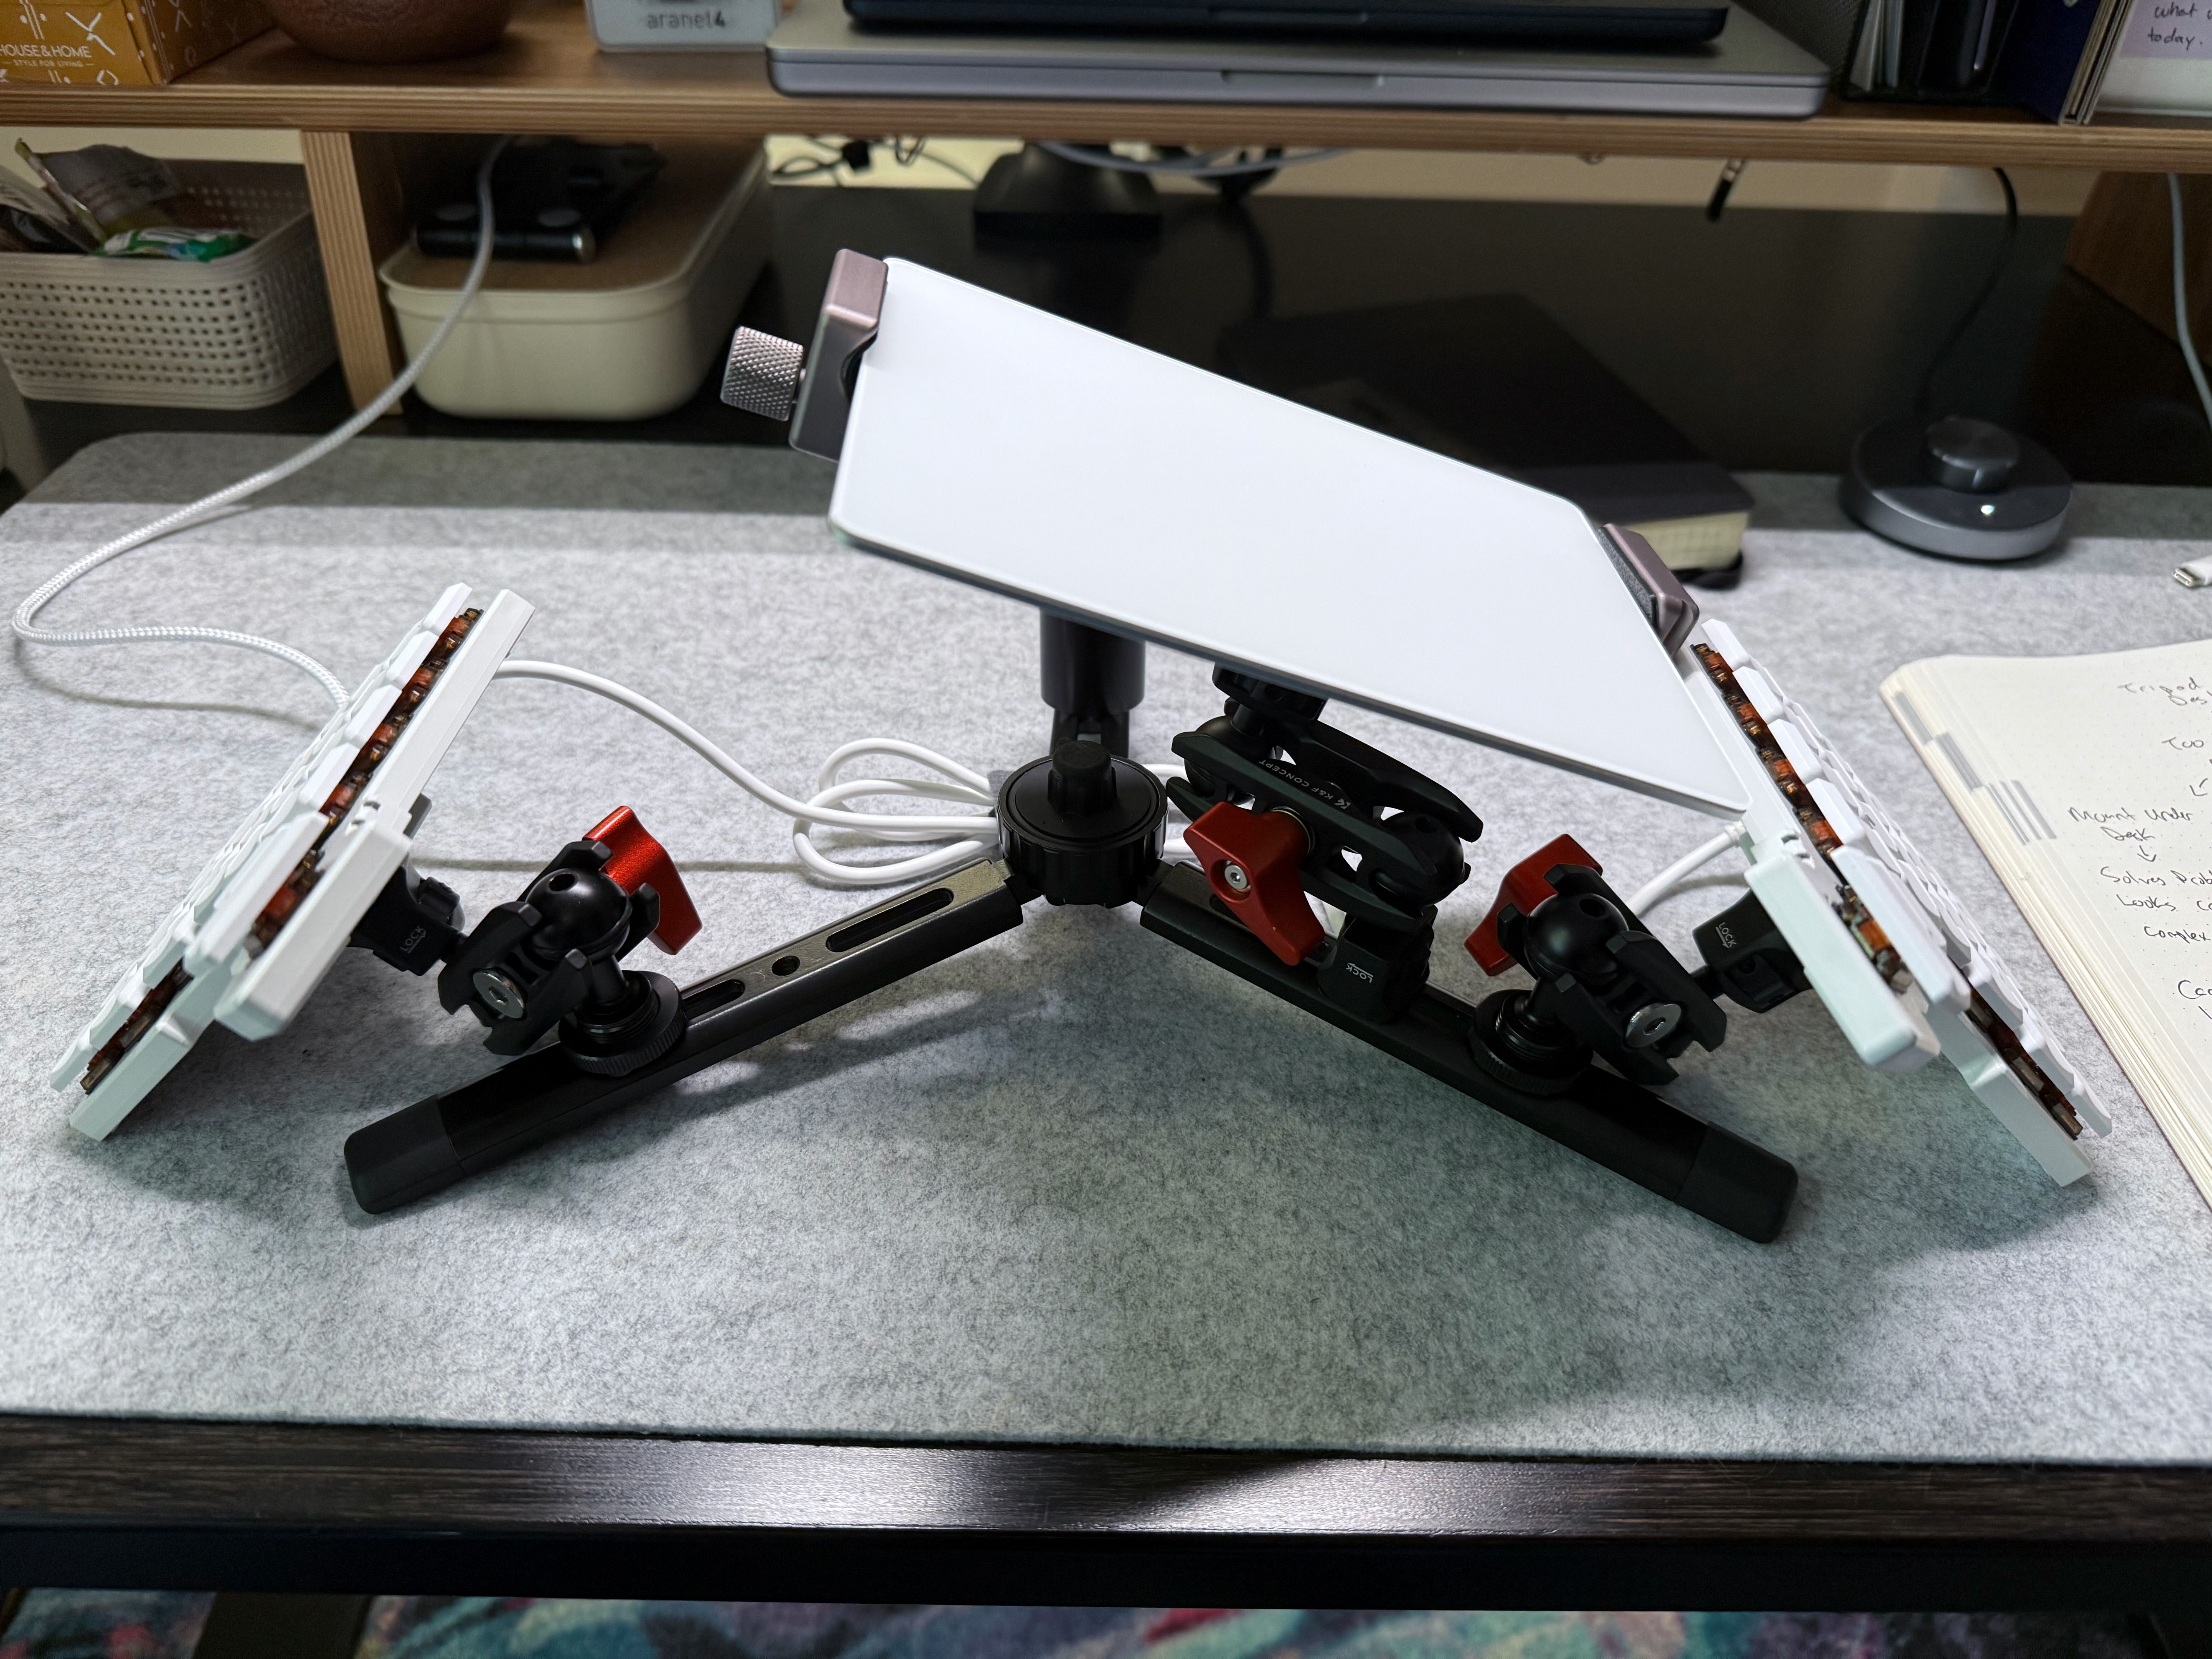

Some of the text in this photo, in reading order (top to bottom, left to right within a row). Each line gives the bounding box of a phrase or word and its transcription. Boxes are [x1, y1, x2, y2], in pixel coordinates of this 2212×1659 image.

[2148, 27, 2203, 51] today.
[1259, 760, 1333, 800] K&F CONCEPT
[400, 925, 425, 951] LOCK
[1719, 922, 1737, 948] LOCK
[1346, 964, 1373, 983] LOCK
